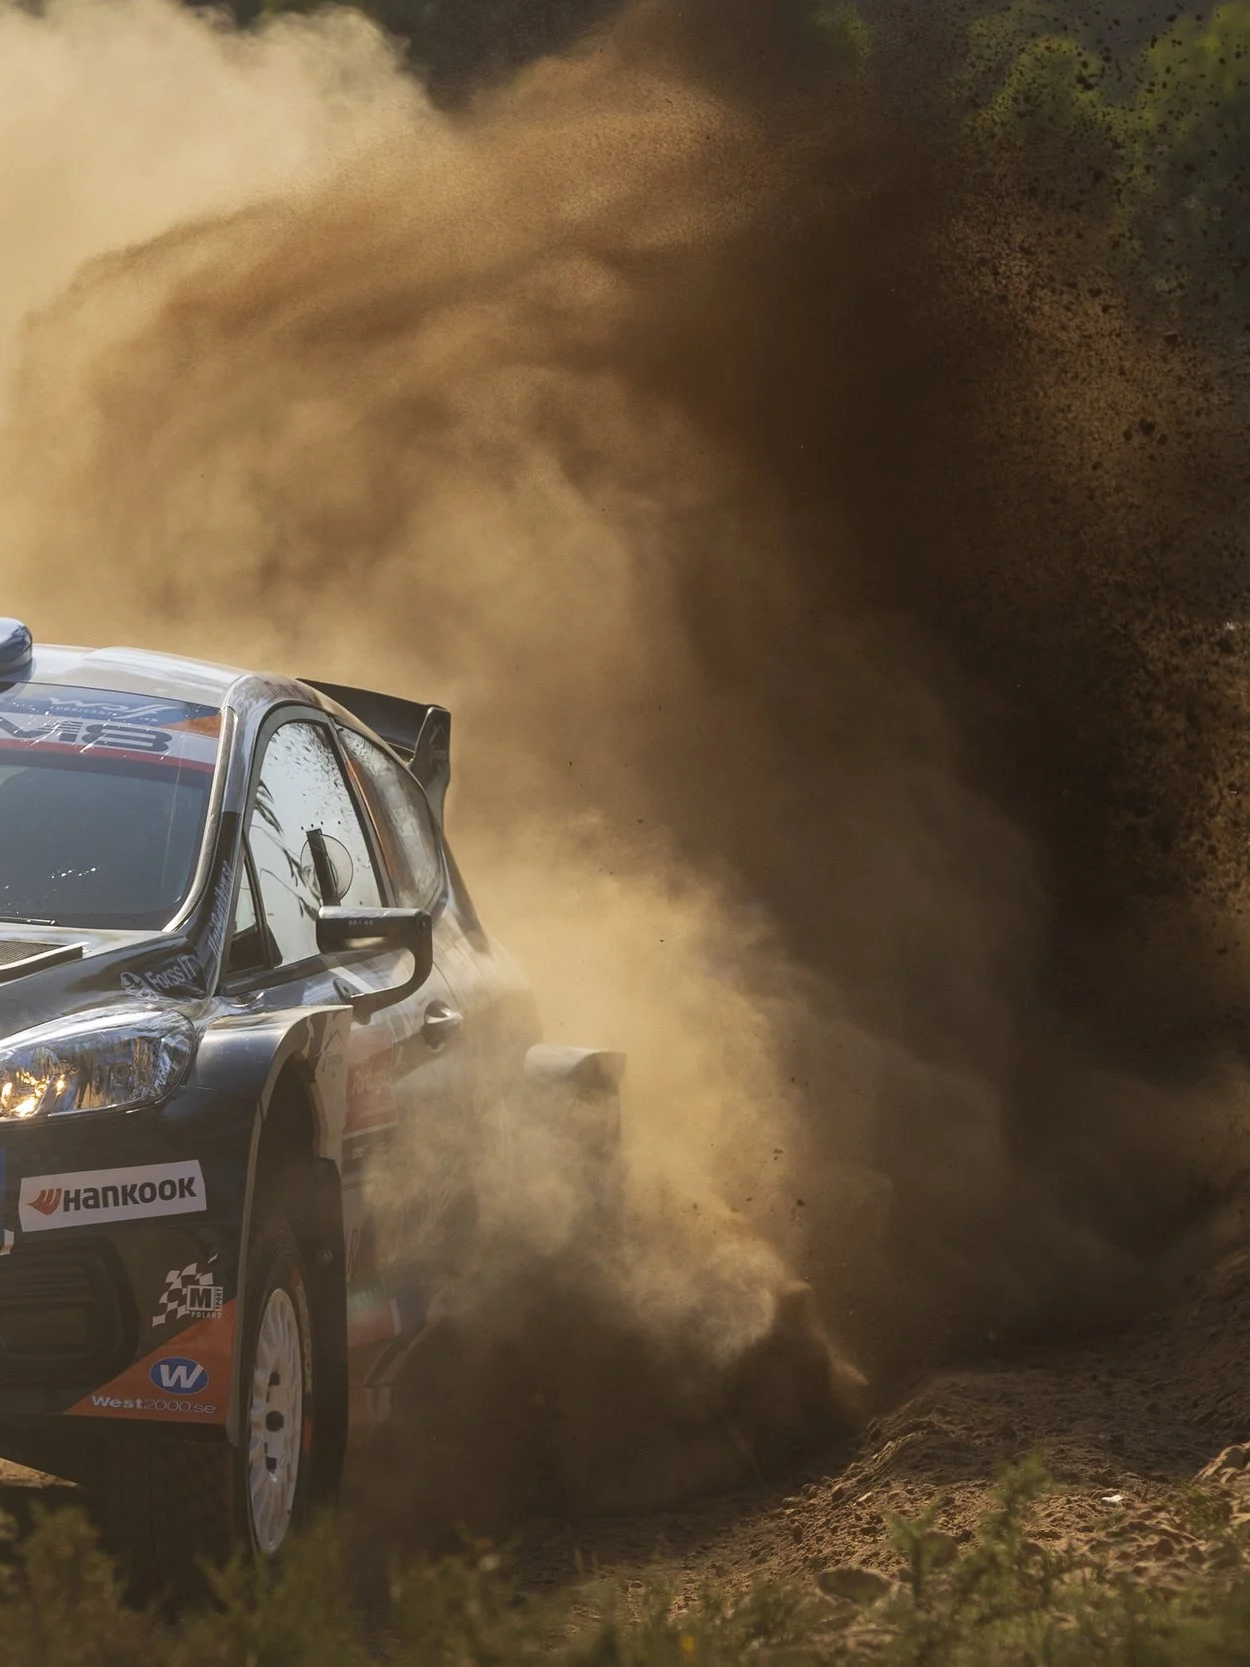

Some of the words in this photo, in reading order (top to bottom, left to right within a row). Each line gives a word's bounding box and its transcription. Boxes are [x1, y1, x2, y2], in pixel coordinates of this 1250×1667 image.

[191, 1311, 223, 1319] POLAND
[159, 1363, 205, 1389] W
[91, 1395, 217, 1414] West2000.se
